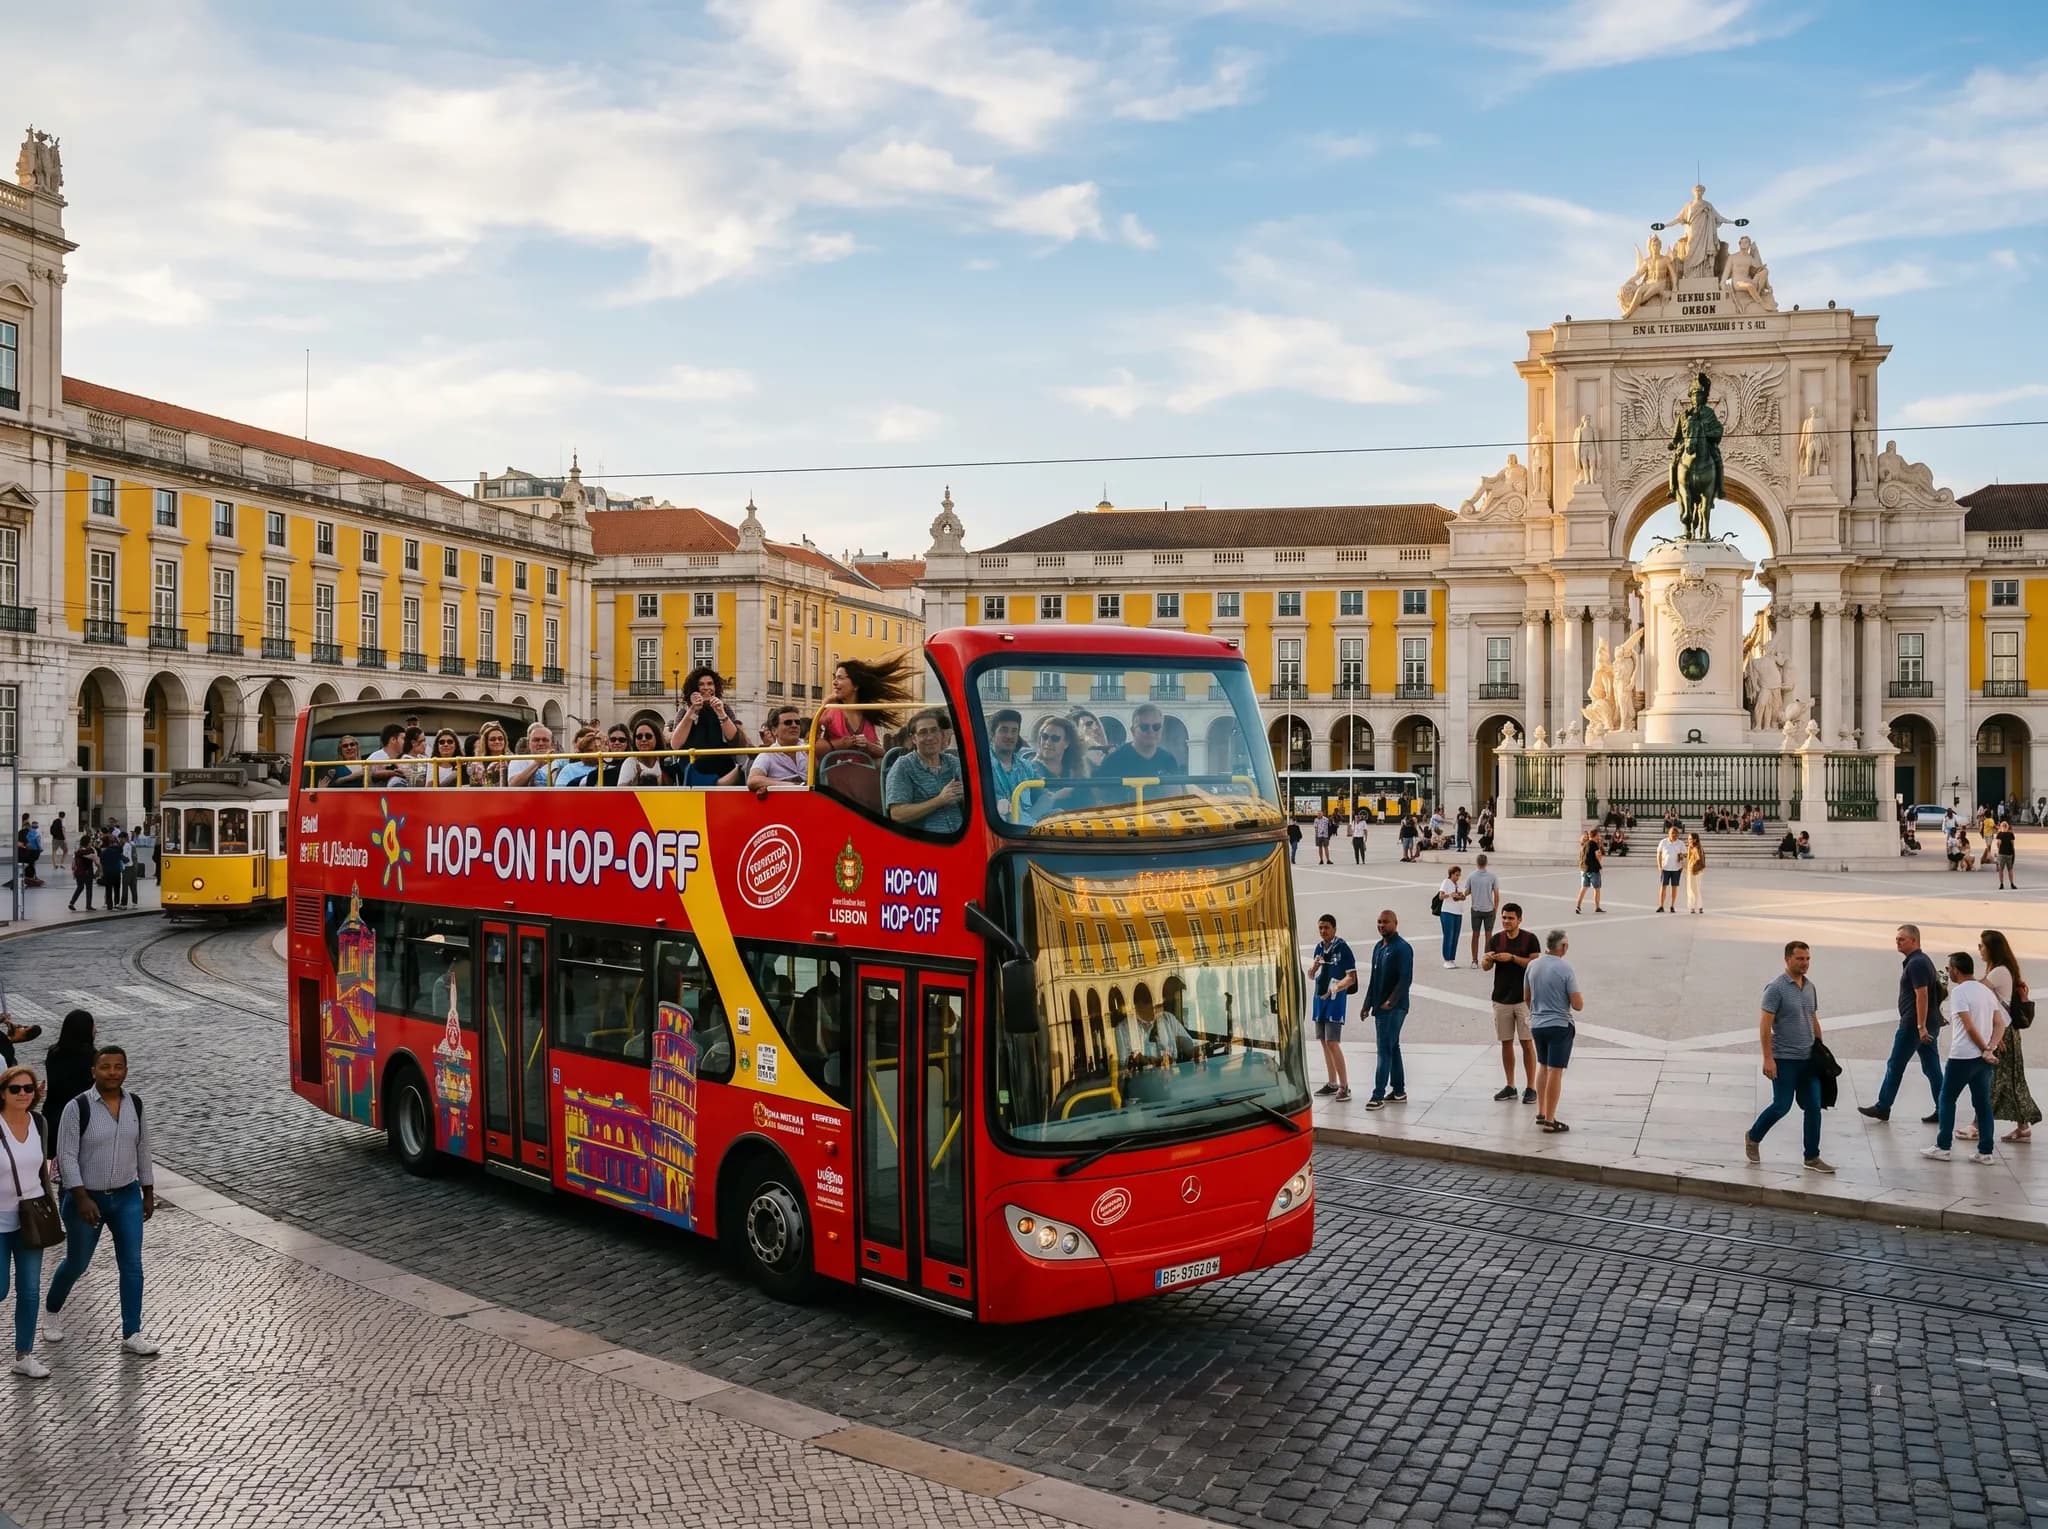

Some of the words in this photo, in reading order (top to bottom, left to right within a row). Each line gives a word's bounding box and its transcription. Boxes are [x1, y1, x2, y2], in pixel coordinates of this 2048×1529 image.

[426, 825, 536, 881] HOP-ON
[546, 829, 700, 892] HOP-OFF
[830, 908, 867, 925] LISBON
